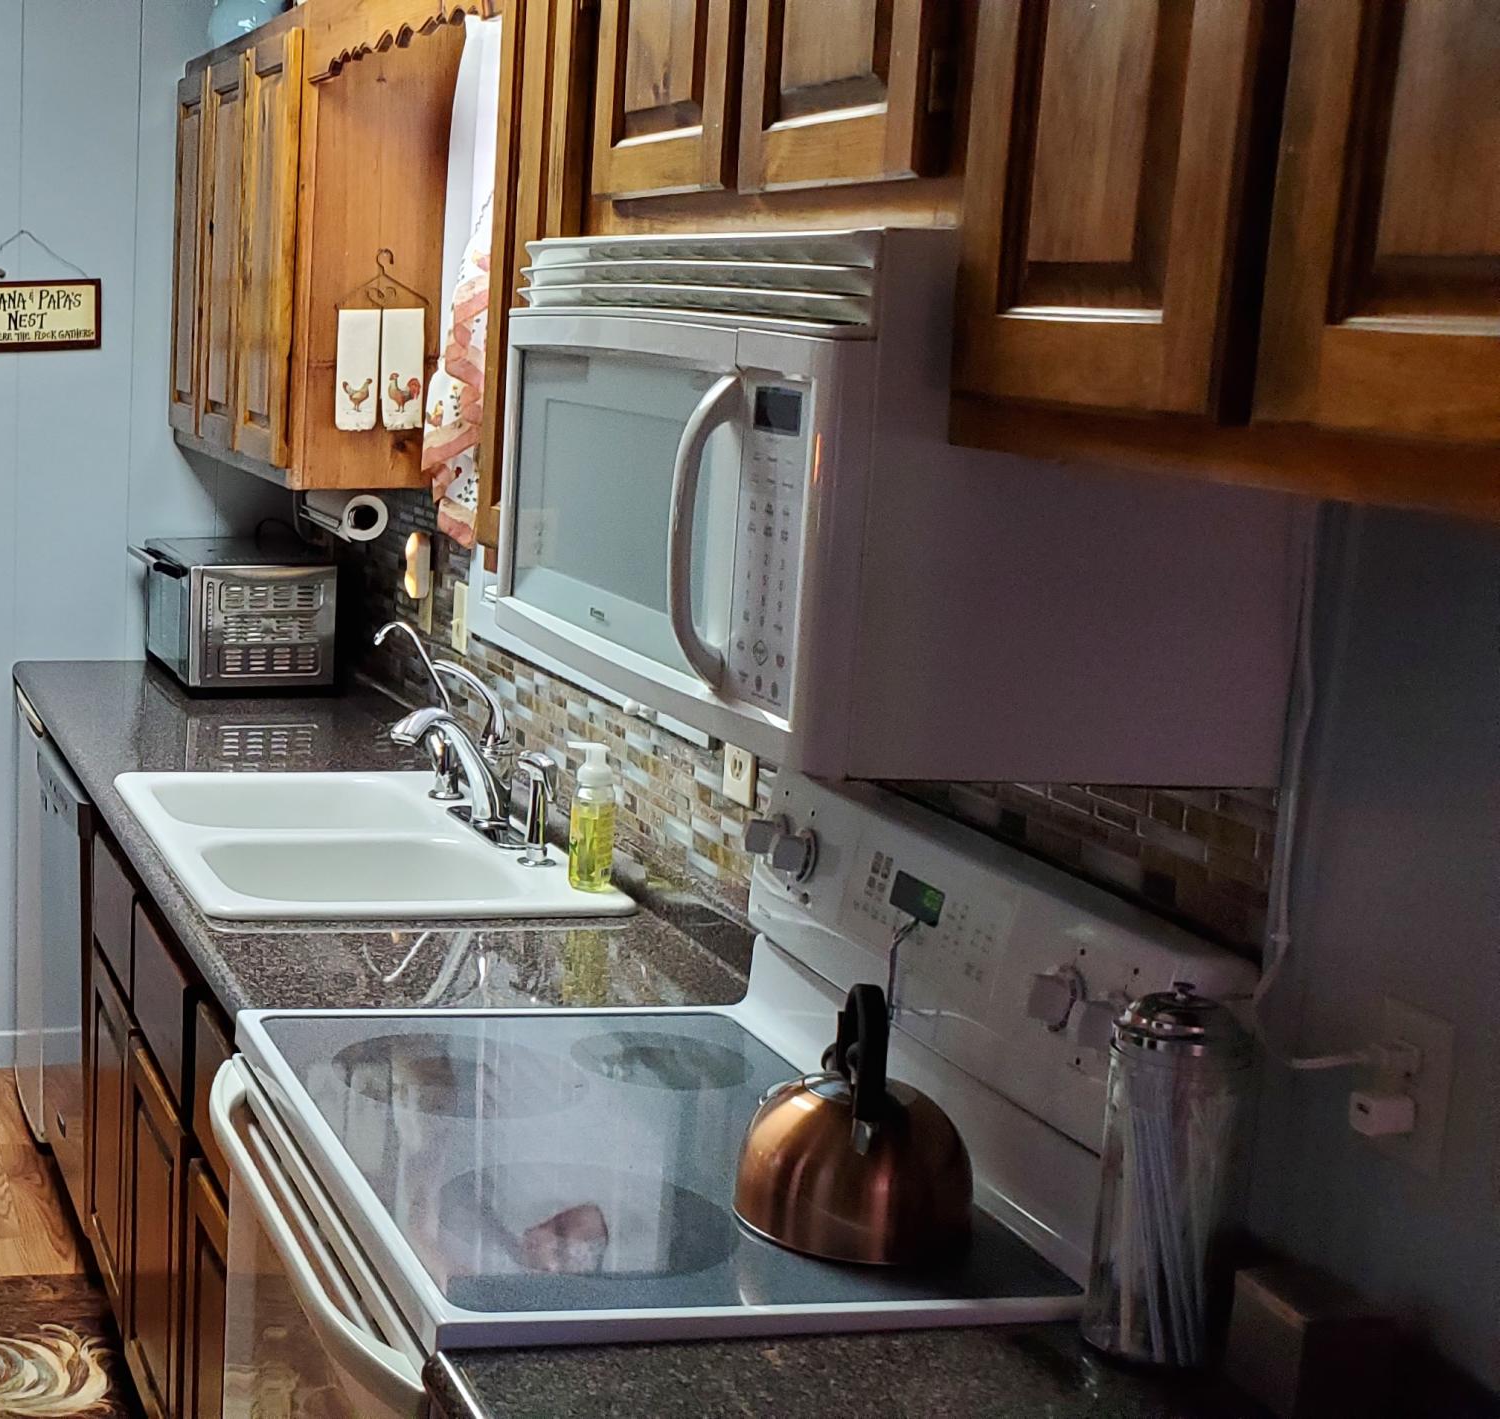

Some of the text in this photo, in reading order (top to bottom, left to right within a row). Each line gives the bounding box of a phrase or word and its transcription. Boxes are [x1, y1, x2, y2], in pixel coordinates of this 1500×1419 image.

[38, 289, 82, 310] PAPA'S
[8, 311, 48, 331] NEST
[35, 330, 57, 341] FLOCK
